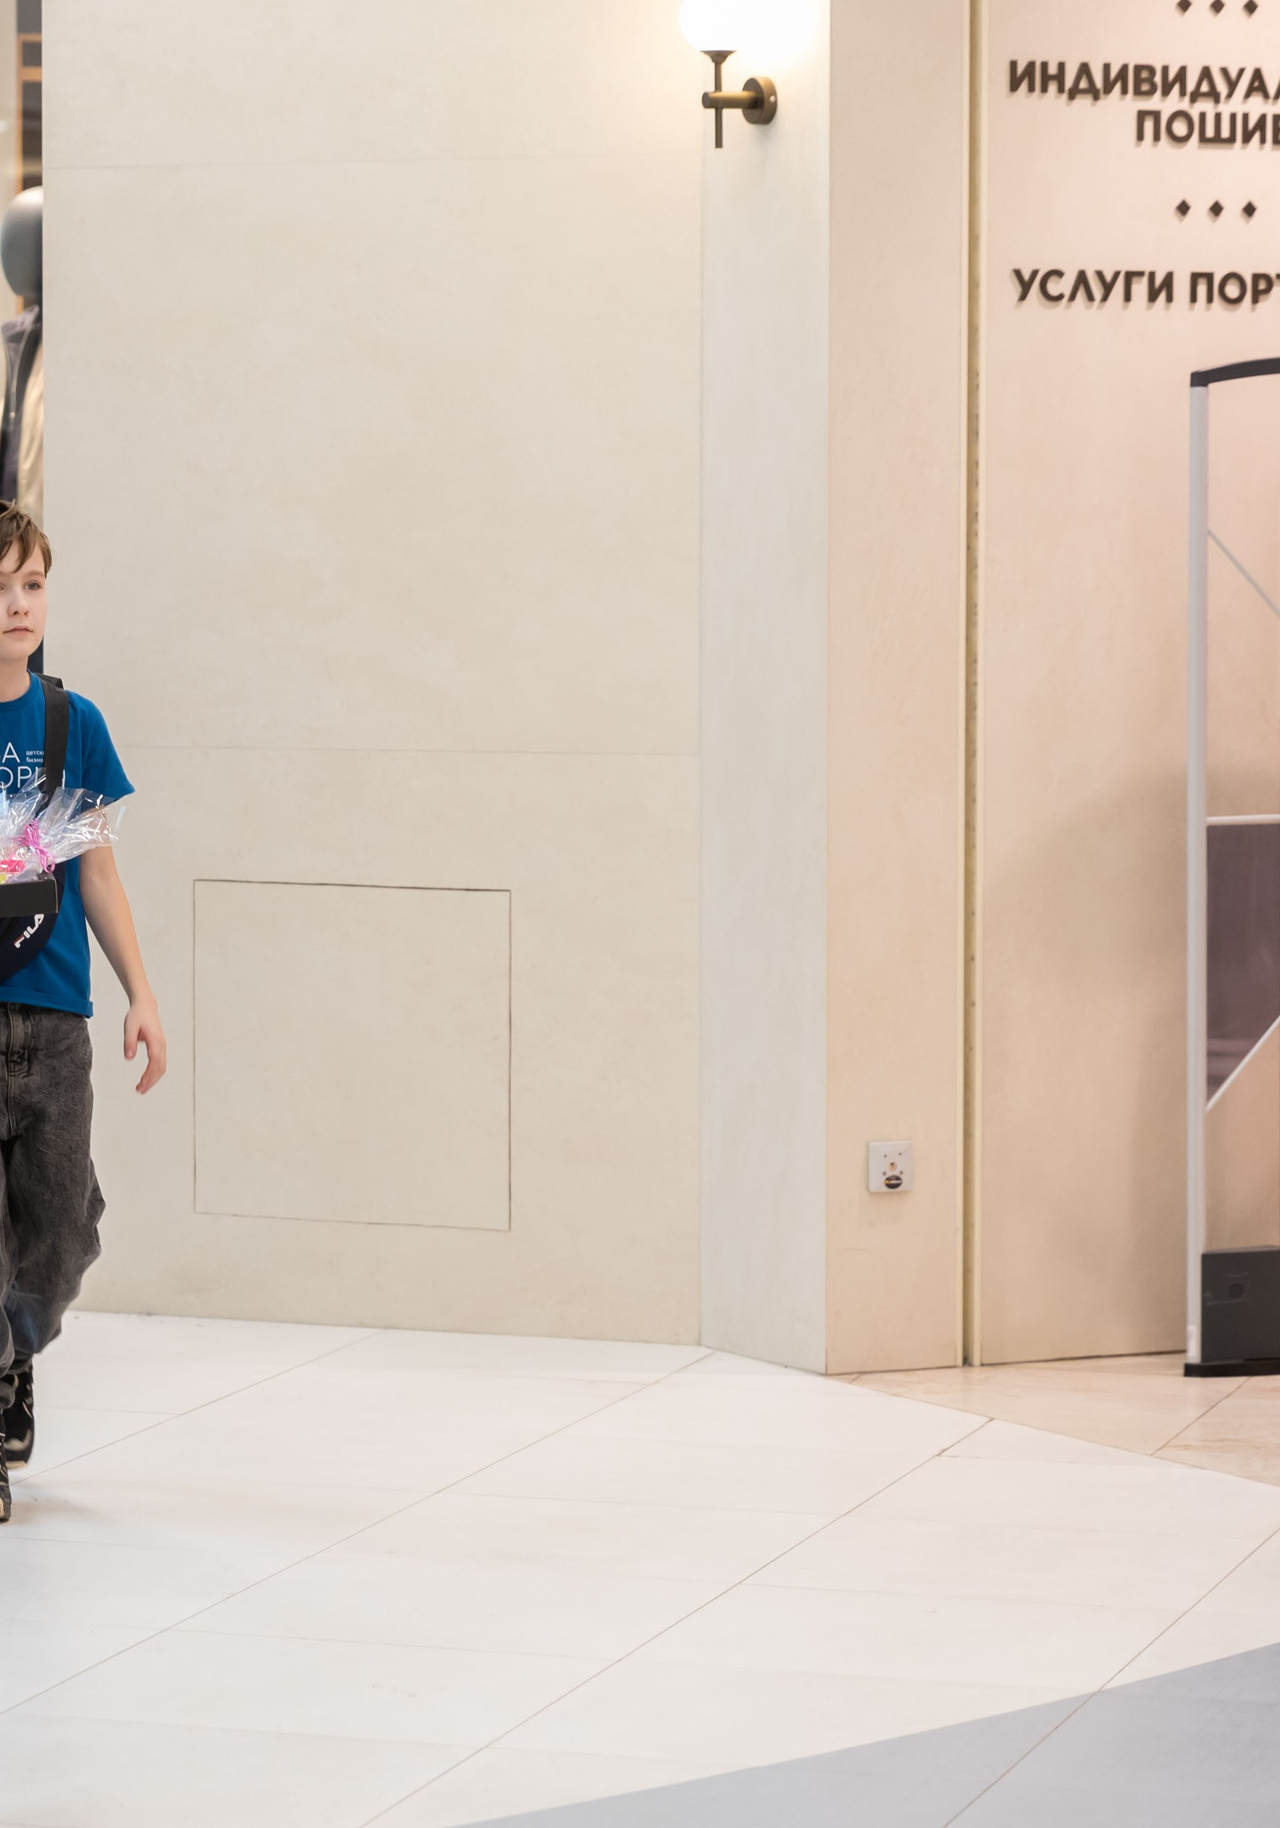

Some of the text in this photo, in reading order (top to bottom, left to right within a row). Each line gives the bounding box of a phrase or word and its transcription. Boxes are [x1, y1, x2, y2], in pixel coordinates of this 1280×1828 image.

[1012, 268, 1280, 304] УСЛУГИ ПОР
[13, 913, 45, 949] FILA
